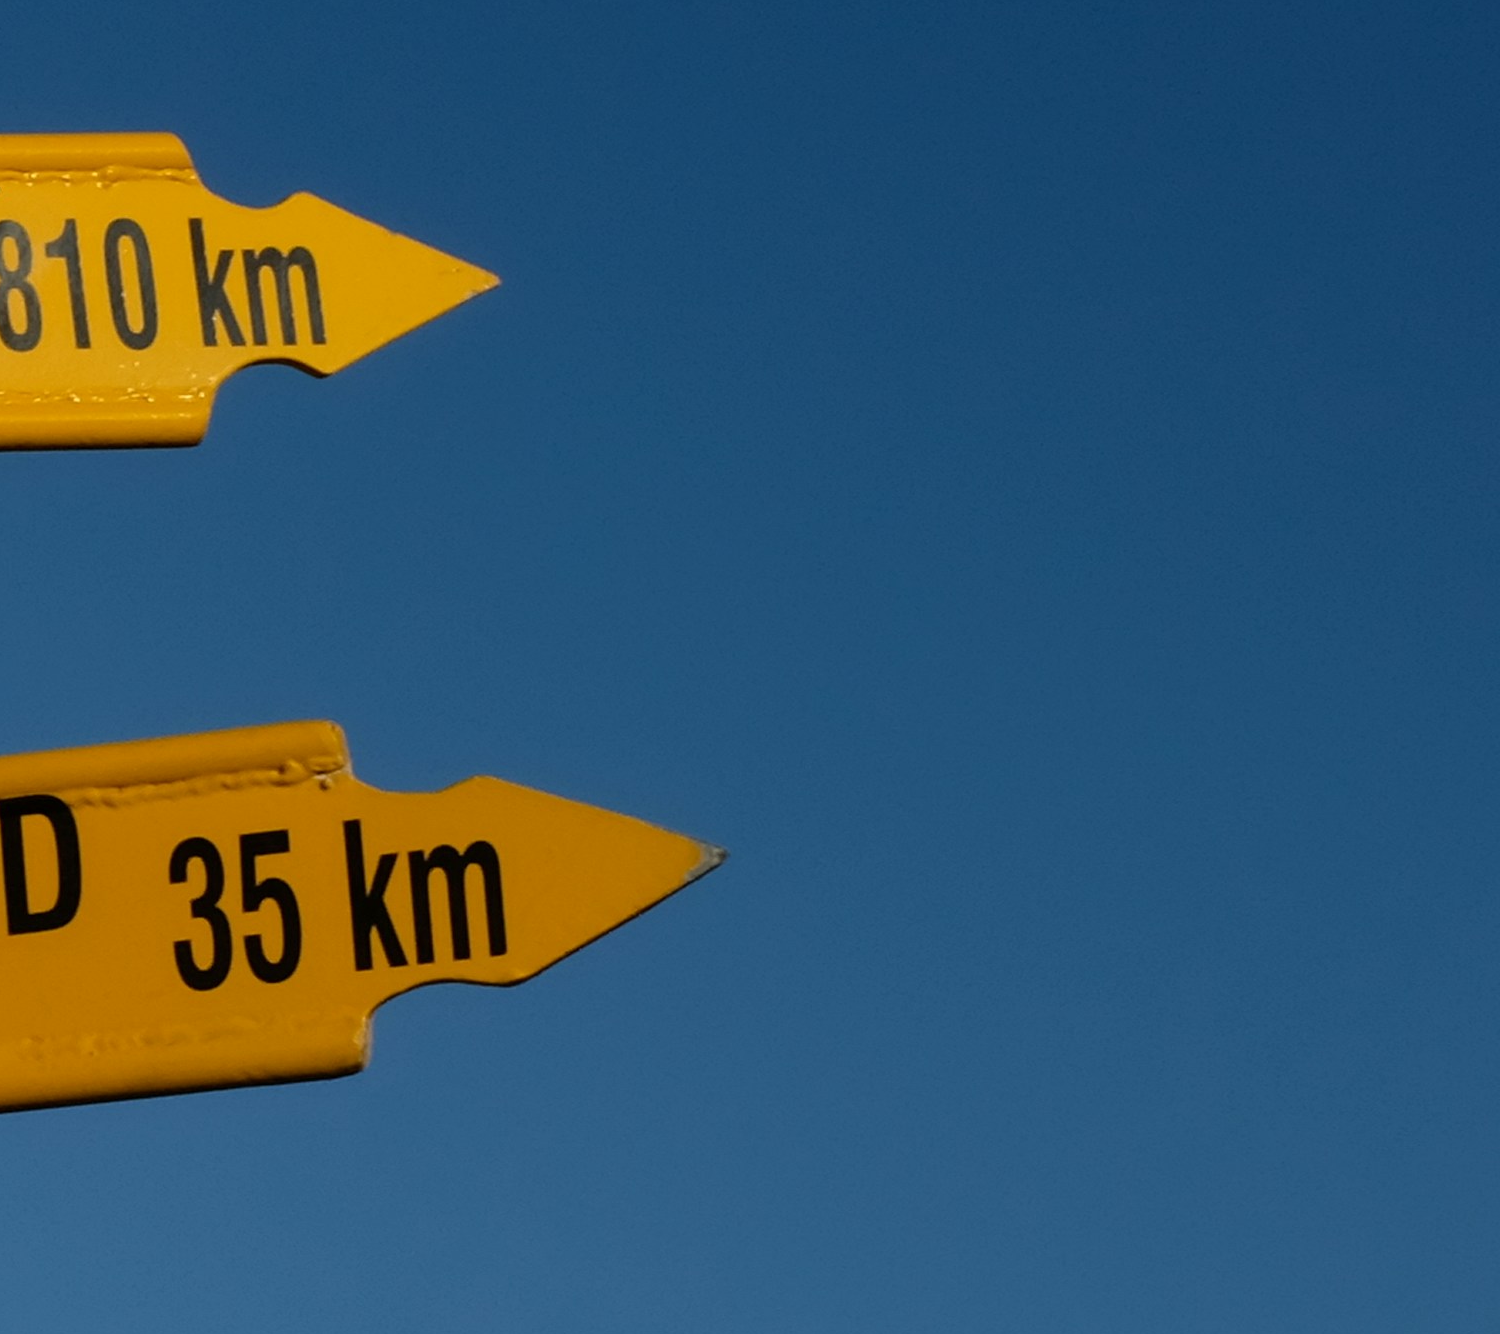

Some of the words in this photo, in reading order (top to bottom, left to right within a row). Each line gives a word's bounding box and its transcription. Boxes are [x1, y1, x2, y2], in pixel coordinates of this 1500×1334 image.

[193, 216, 330, 348] km
[167, 828, 302, 994] 35
[346, 821, 509, 974] km
